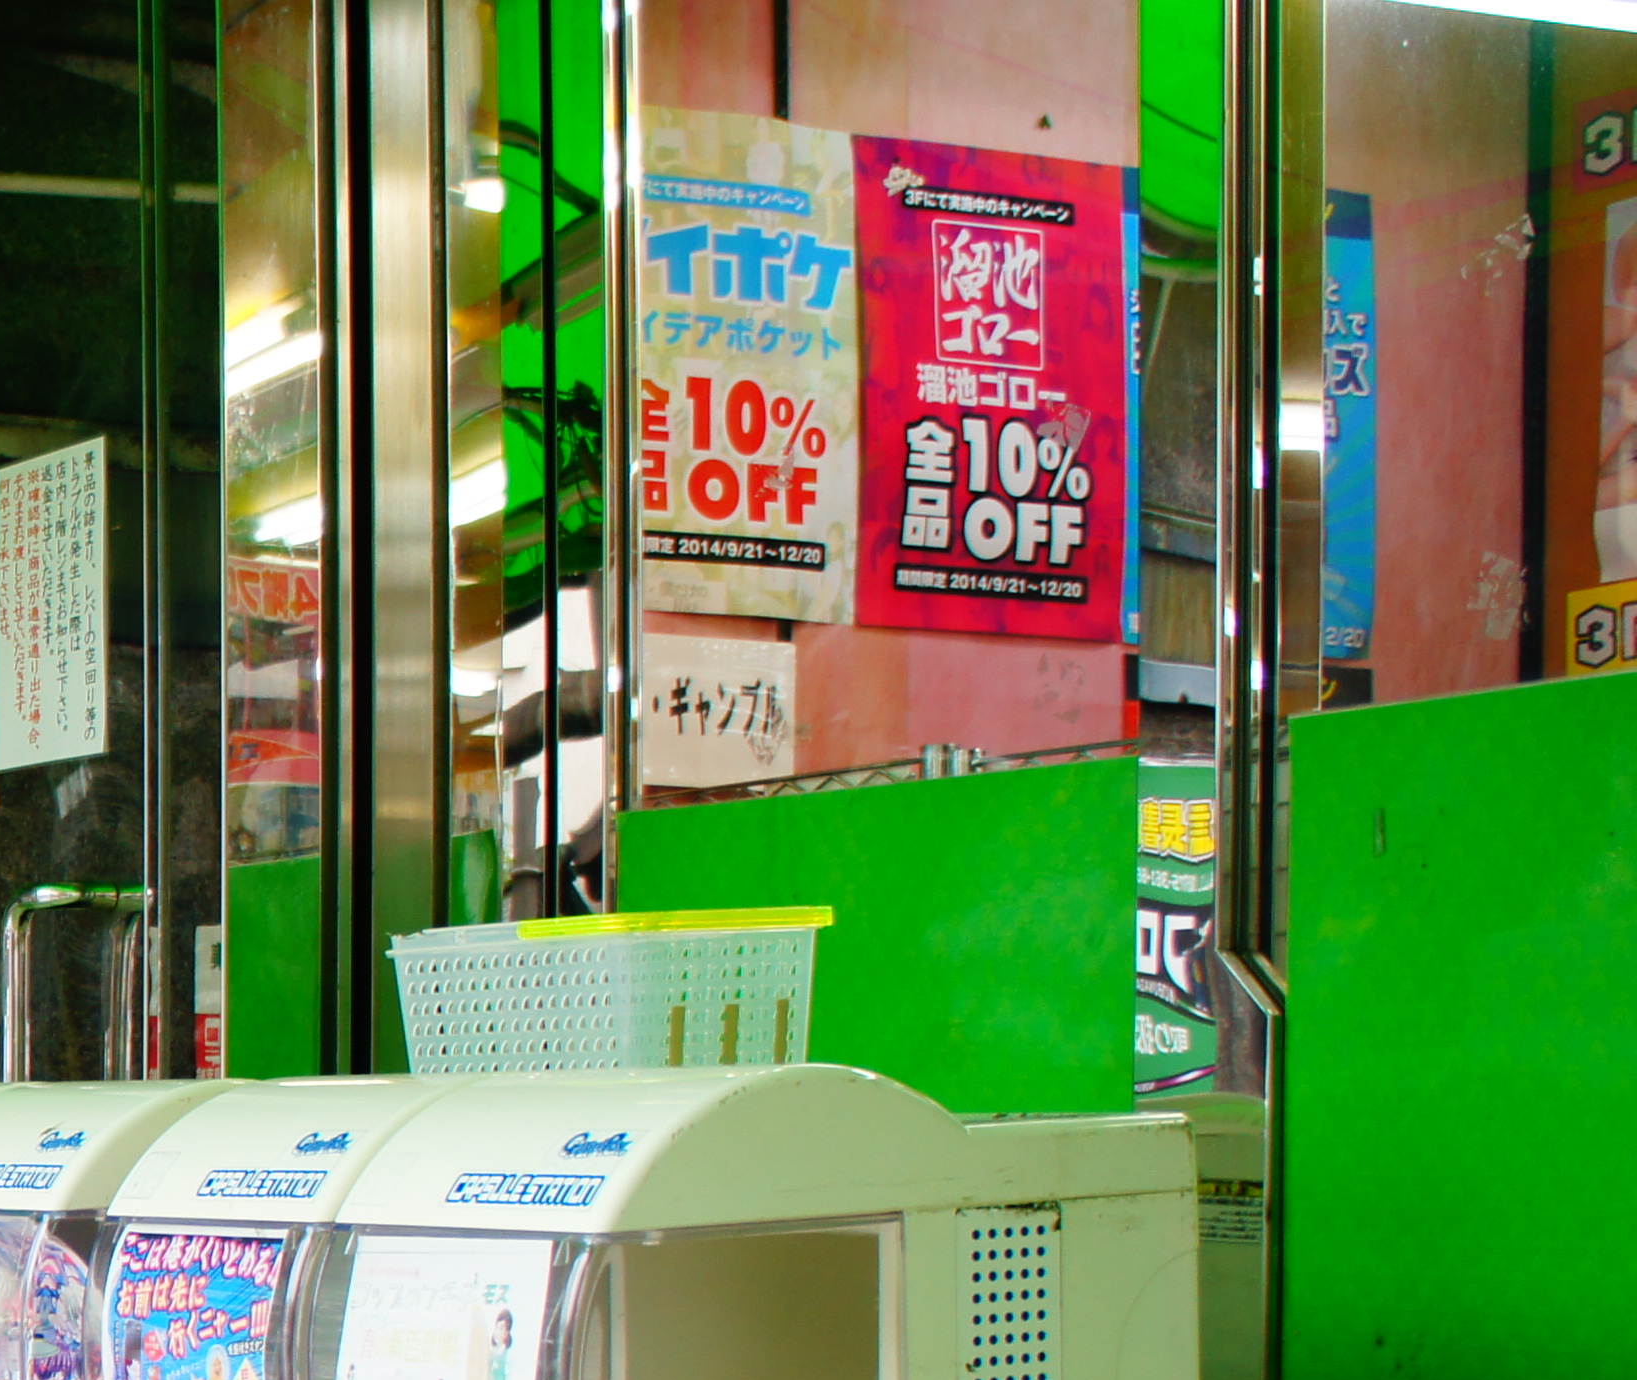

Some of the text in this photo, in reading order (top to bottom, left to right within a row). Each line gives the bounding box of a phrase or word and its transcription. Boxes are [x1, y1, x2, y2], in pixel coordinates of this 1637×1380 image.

[642, 217, 853, 309] イポケ
[939, 227, 1041, 310] 溜池
[941, 304, 1041, 356] ゴロー
[915, 362, 1067, 412] 溜池ゴロー
[685, 375, 827, 460] 10%
[901, 419, 955, 550] 全品
[962, 417, 1092, 500] 10%
[686, 458, 819, 526] OFF
[643, 532, 674, 556] 限定
[963, 496, 1085, 566] OFF
[896, 569, 948, 590] 期間限定
[445, 1172, 606, 1208] CAPSULE STATION
[116, 1271, 209, 1319] お前は先に
[482, 1282, 513, 1306] モス
